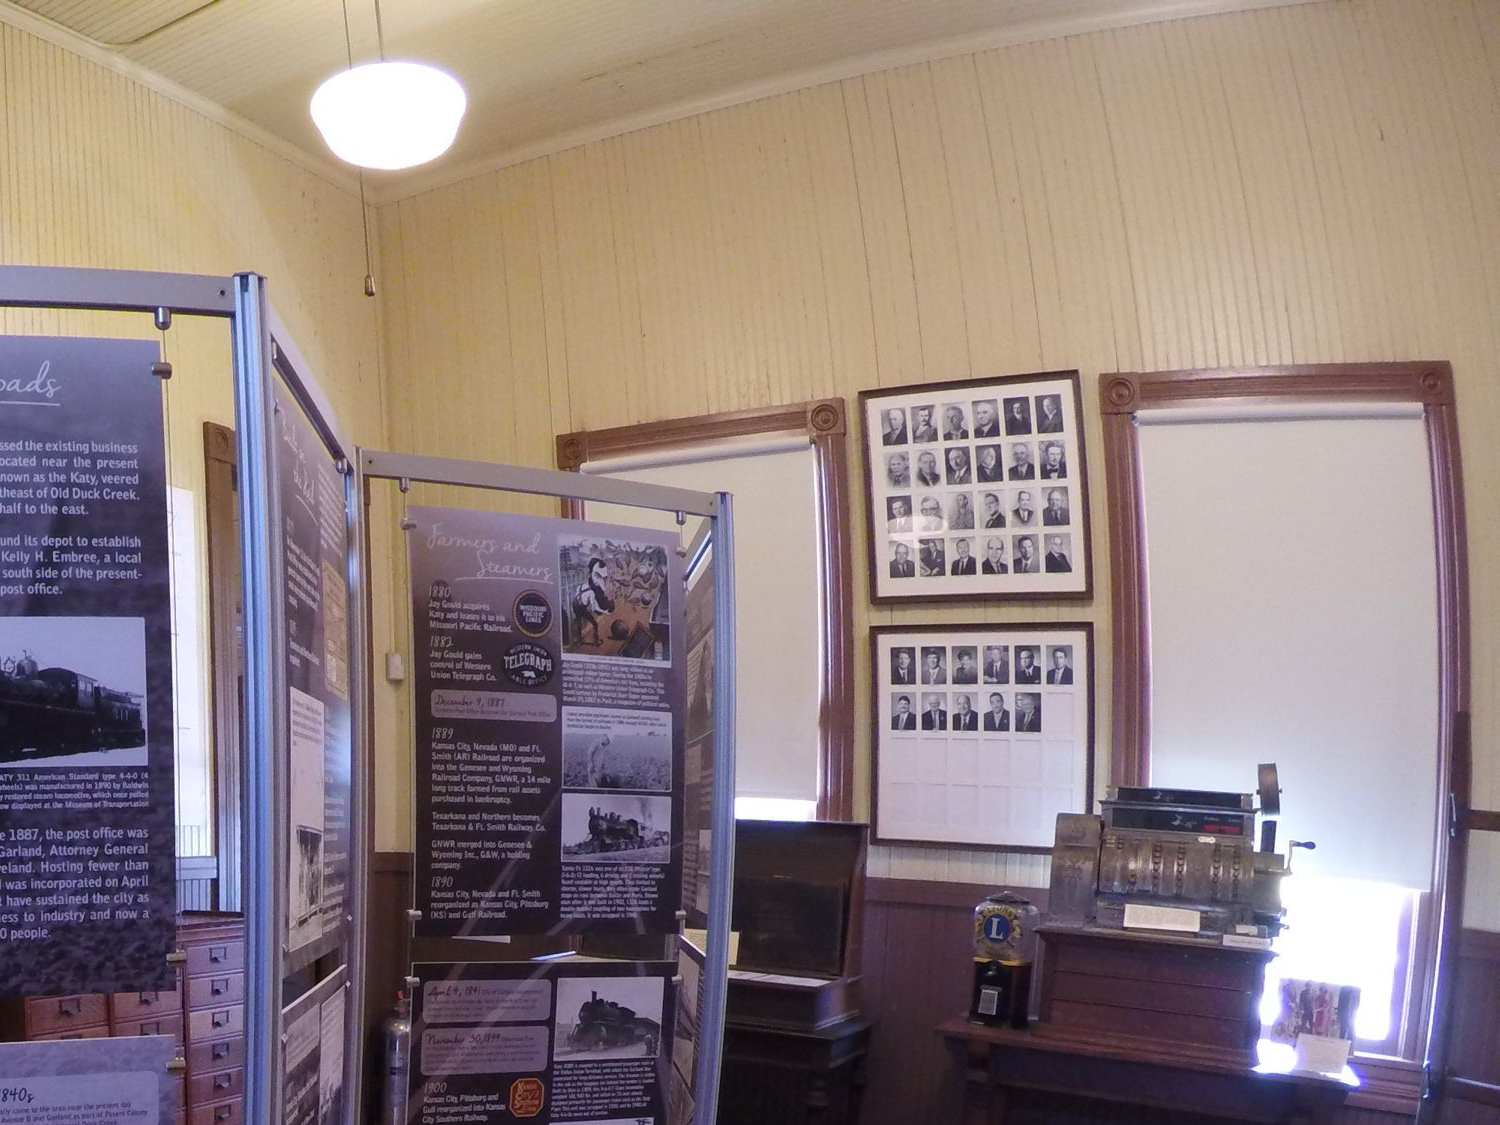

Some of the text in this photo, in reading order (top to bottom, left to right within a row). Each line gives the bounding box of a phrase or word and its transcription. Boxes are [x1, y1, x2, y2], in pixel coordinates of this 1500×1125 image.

[24, 439, 44, 452] the
[44, 439, 90, 454] existing
[90, 439, 138, 454] business
[427, 523, 541, 554] Farmers and
[476, 550, 552, 578] Steamers
[428, 585, 451, 598] 1880
[430, 636, 453, 648] 1882
[504, 653, 552, 672] TELEGRAPH
[431, 727, 454, 740] 1889
[431, 875, 454, 888] 1890
[10, 926, 52, 942] people.
[989, 917, 1004, 940] L
[423, 1082, 447, 1093] 1900
